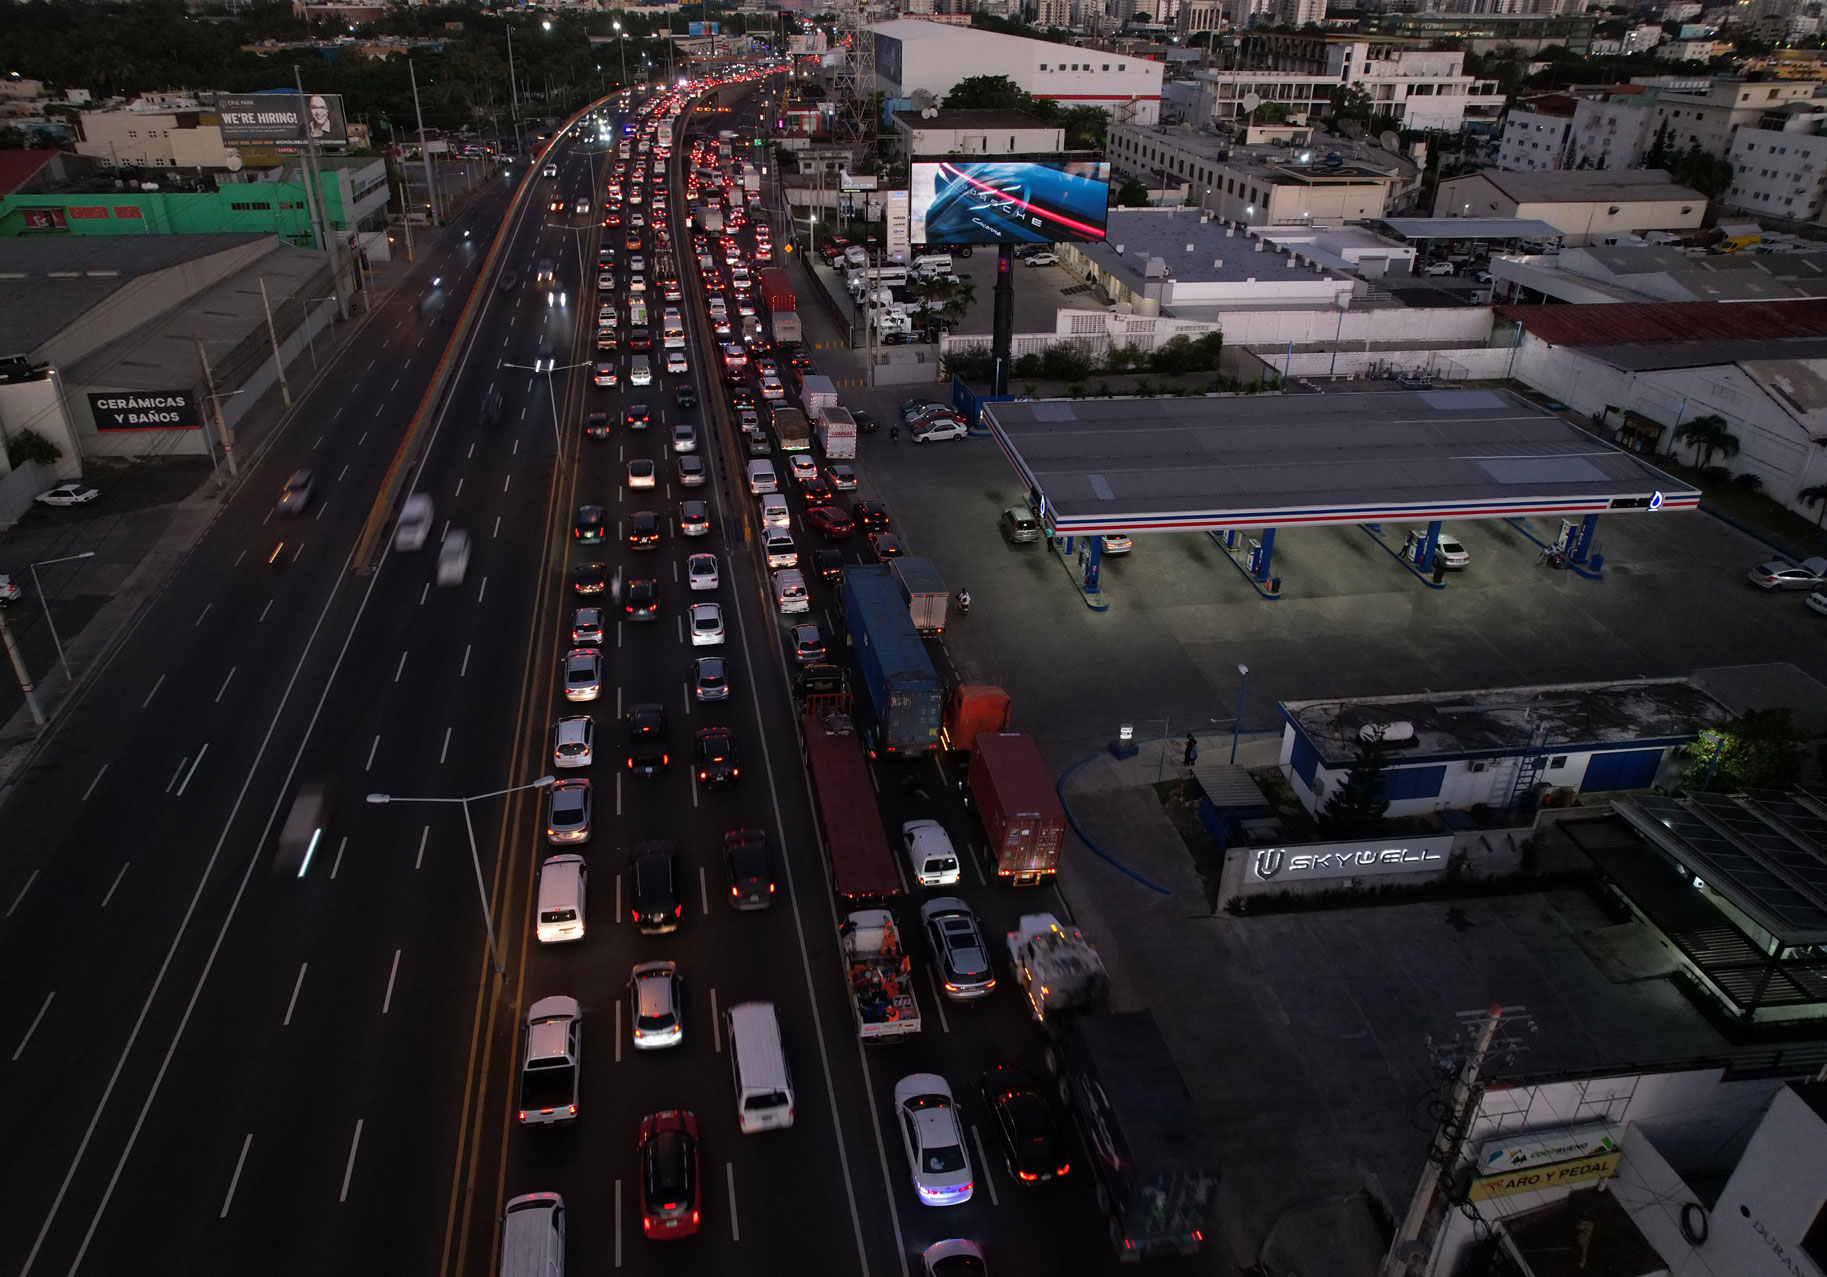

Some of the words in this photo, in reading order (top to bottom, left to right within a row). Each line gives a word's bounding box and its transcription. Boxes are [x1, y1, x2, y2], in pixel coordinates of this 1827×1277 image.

[222, 112, 257, 125] WE'RE
[257, 112, 298, 124] HIRING!
[957, 185, 1042, 228] PORSCHE
[97, 395, 186, 410] CERÁMICAS
[114, 414, 124, 424] Y
[128, 410, 180, 424] BAÑOS
[1288, 849, 1441, 870] SKYWELL
[1505, 1175, 1540, 1190] ARO
[1546, 1171, 1556, 1181] Y
[1558, 1161, 1610, 1179] PEDAL
